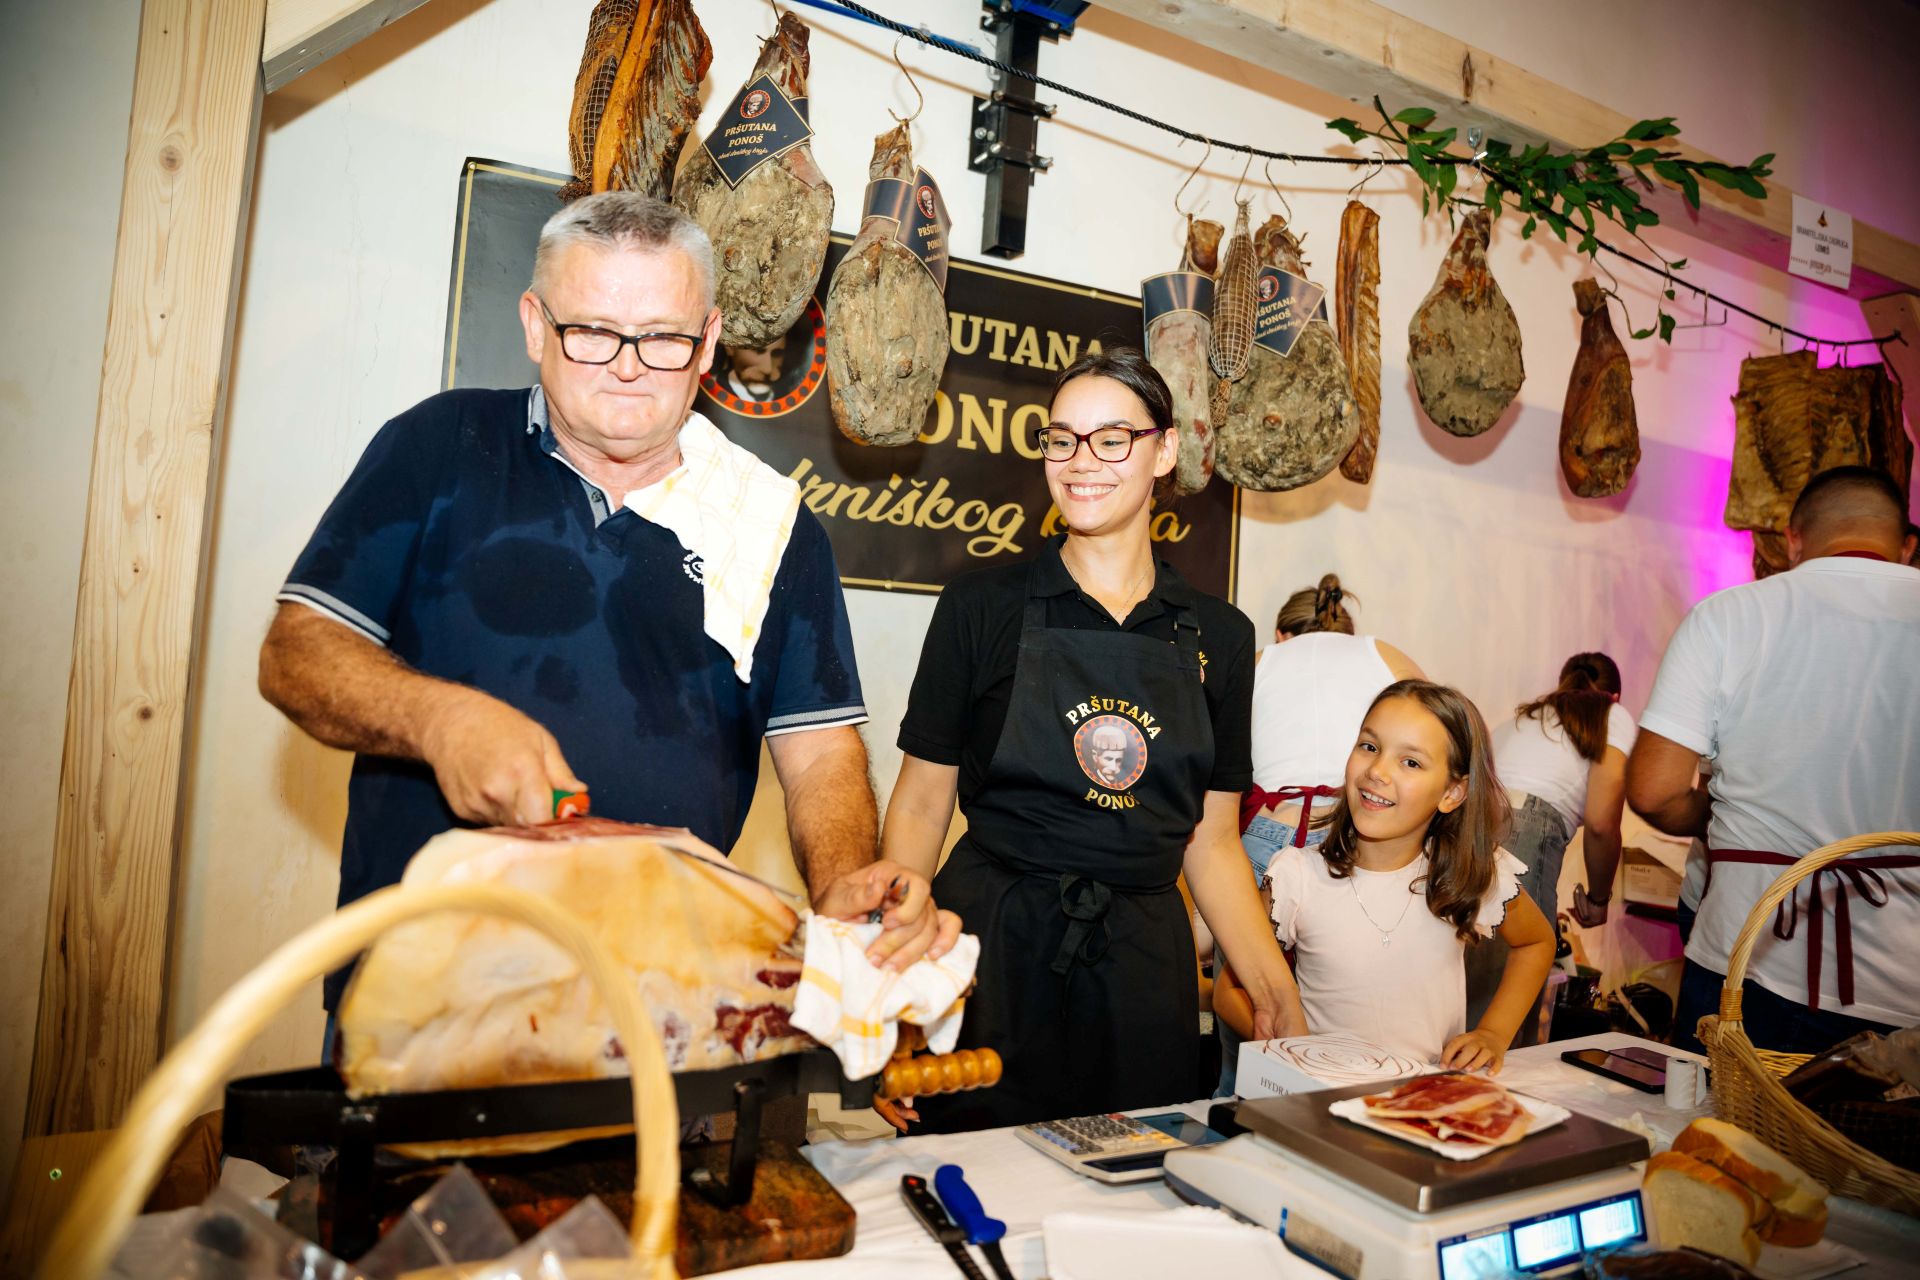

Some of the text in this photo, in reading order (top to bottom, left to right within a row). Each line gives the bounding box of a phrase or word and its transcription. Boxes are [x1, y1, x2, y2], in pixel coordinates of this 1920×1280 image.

[724, 122, 777, 137] PRŠUTANA
[728, 133, 764, 148] PONOŠ
[1257, 296, 1296, 317] ŠUTANA
[1259, 308, 1292, 328] PONOŠ
[949, 311, 1102, 371] UTAN
[1065, 695, 1162, 740] PRŠUTANA
[1084, 788, 1140, 810] PONO
